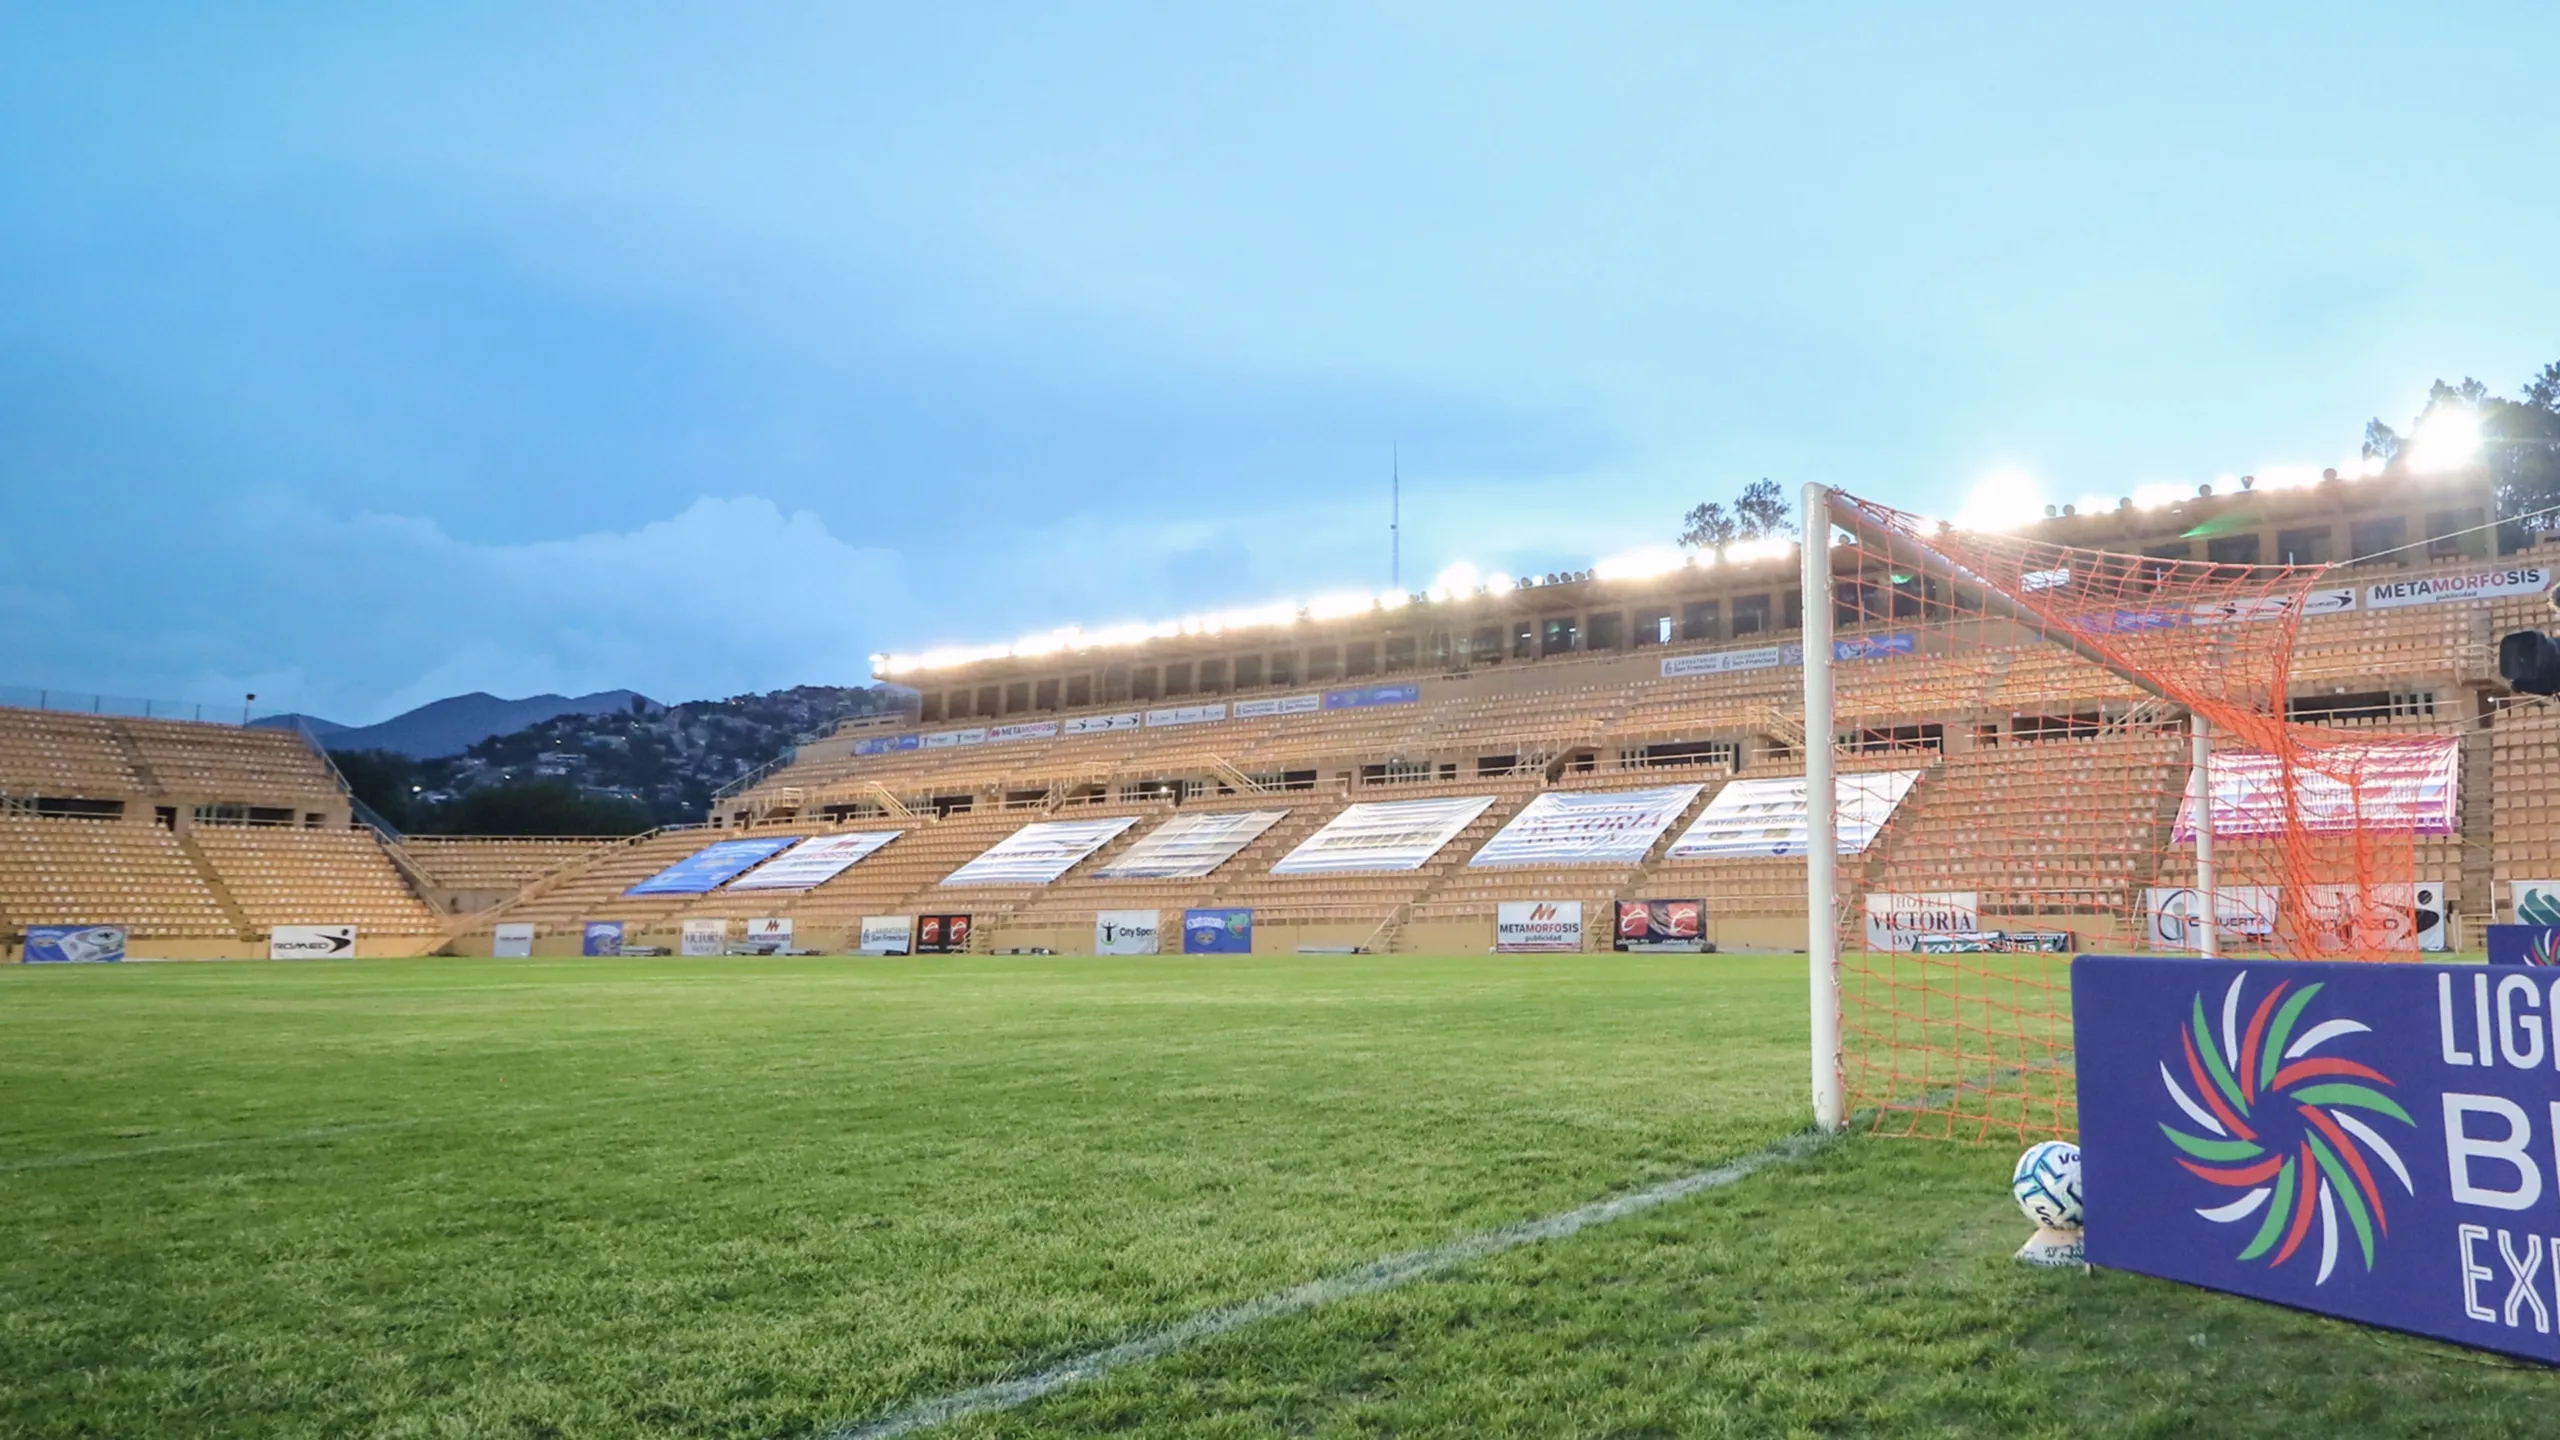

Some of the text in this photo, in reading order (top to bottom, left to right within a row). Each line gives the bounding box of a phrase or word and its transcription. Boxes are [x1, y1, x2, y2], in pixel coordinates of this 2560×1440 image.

[2374, 569, 2541, 600] METAMORFOSIS
[1896, 897, 1949, 908] HOTEL
[1500, 924, 1580, 933] METAMORFOSIS
[1873, 911, 1972, 930] VICTORIA
[273, 942, 329, 950] ROMED
[2438, 972, 2560, 1072] LIG
[2441, 1092, 2560, 1211] B
[2458, 1222, 2560, 1334] EX
